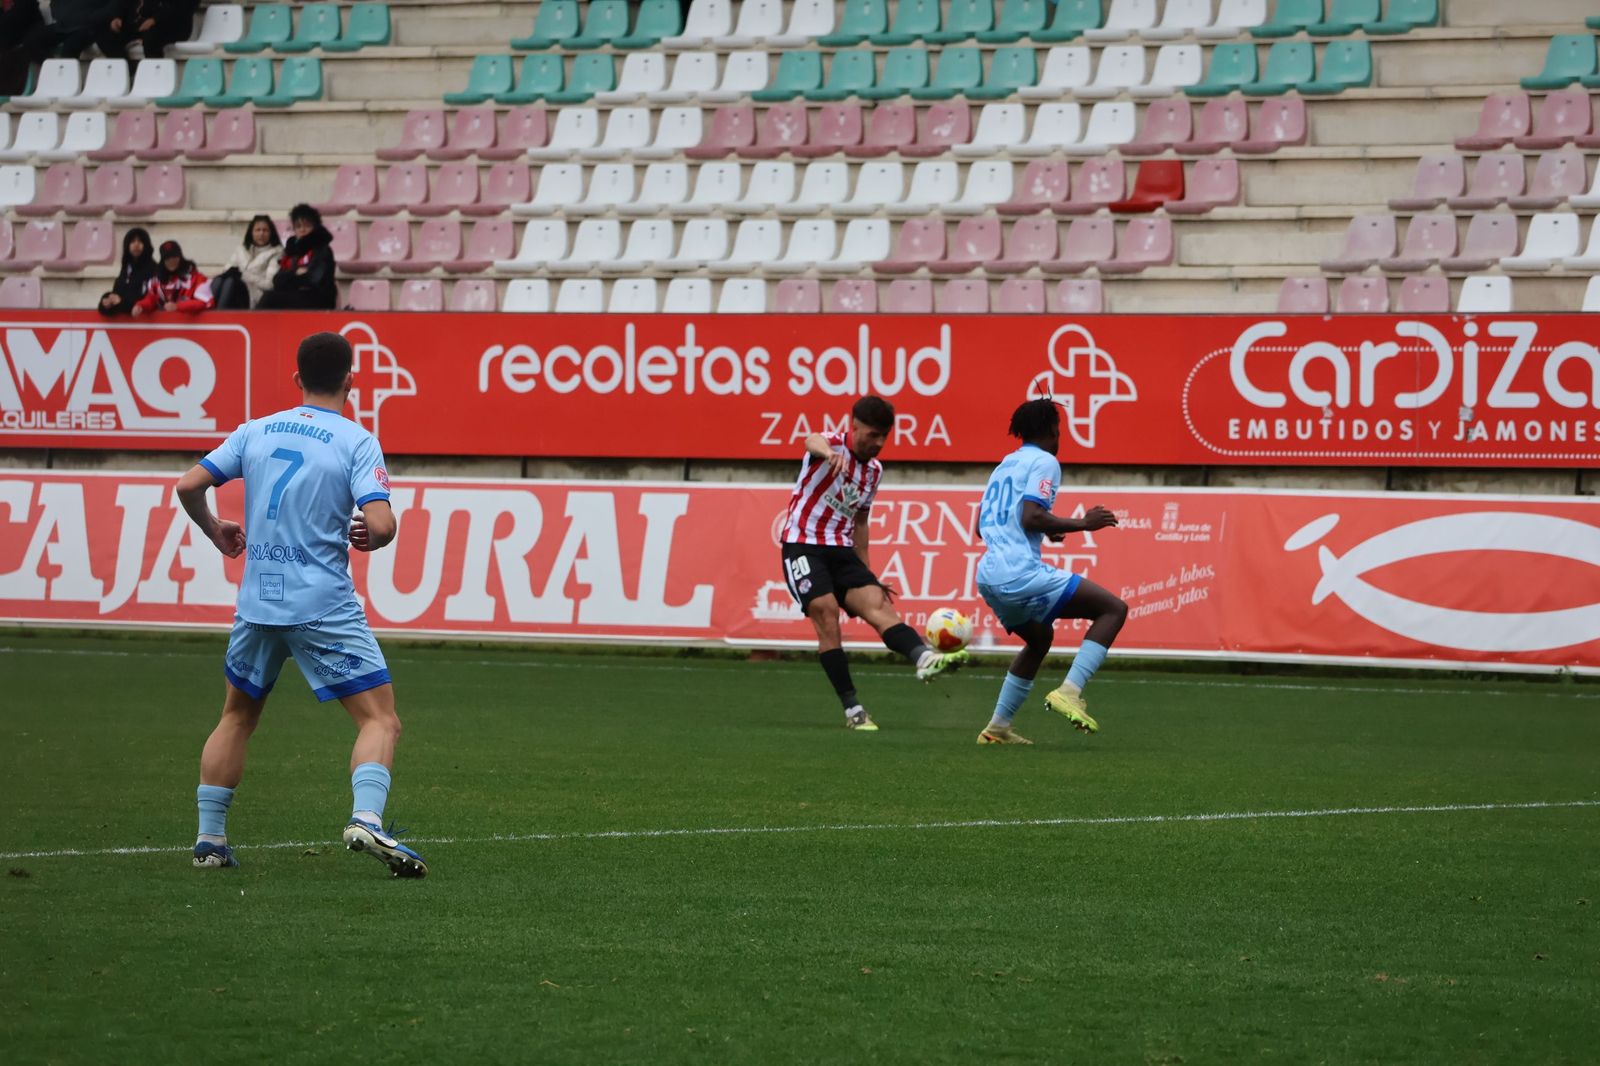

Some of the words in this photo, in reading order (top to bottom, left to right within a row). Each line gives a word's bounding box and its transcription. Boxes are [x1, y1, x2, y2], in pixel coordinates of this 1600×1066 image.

[478, 323, 771, 395] recoletas
[788, 323, 951, 396] salud
[0, 410, 116, 430] QUILERES
[264, 421, 334, 444] PEDERNALES
[760, 412, 952, 446] ZAMRA
[1228, 418, 1414, 441] EMBUTIDOS
[1428, 420, 1441, 440] Y
[266, 447, 305, 520] 7
[980, 475, 1013, 528] 20
[867, 500, 1098, 549] ERNA
[1116, 517, 1152, 531] PULSA
[350, 486, 714, 628] URAL
[791, 555, 812, 580] 20
[878, 550, 1098, 602] ALIE
[1137, 581, 1164, 596] tierra
[1166, 573, 1177, 588] de
